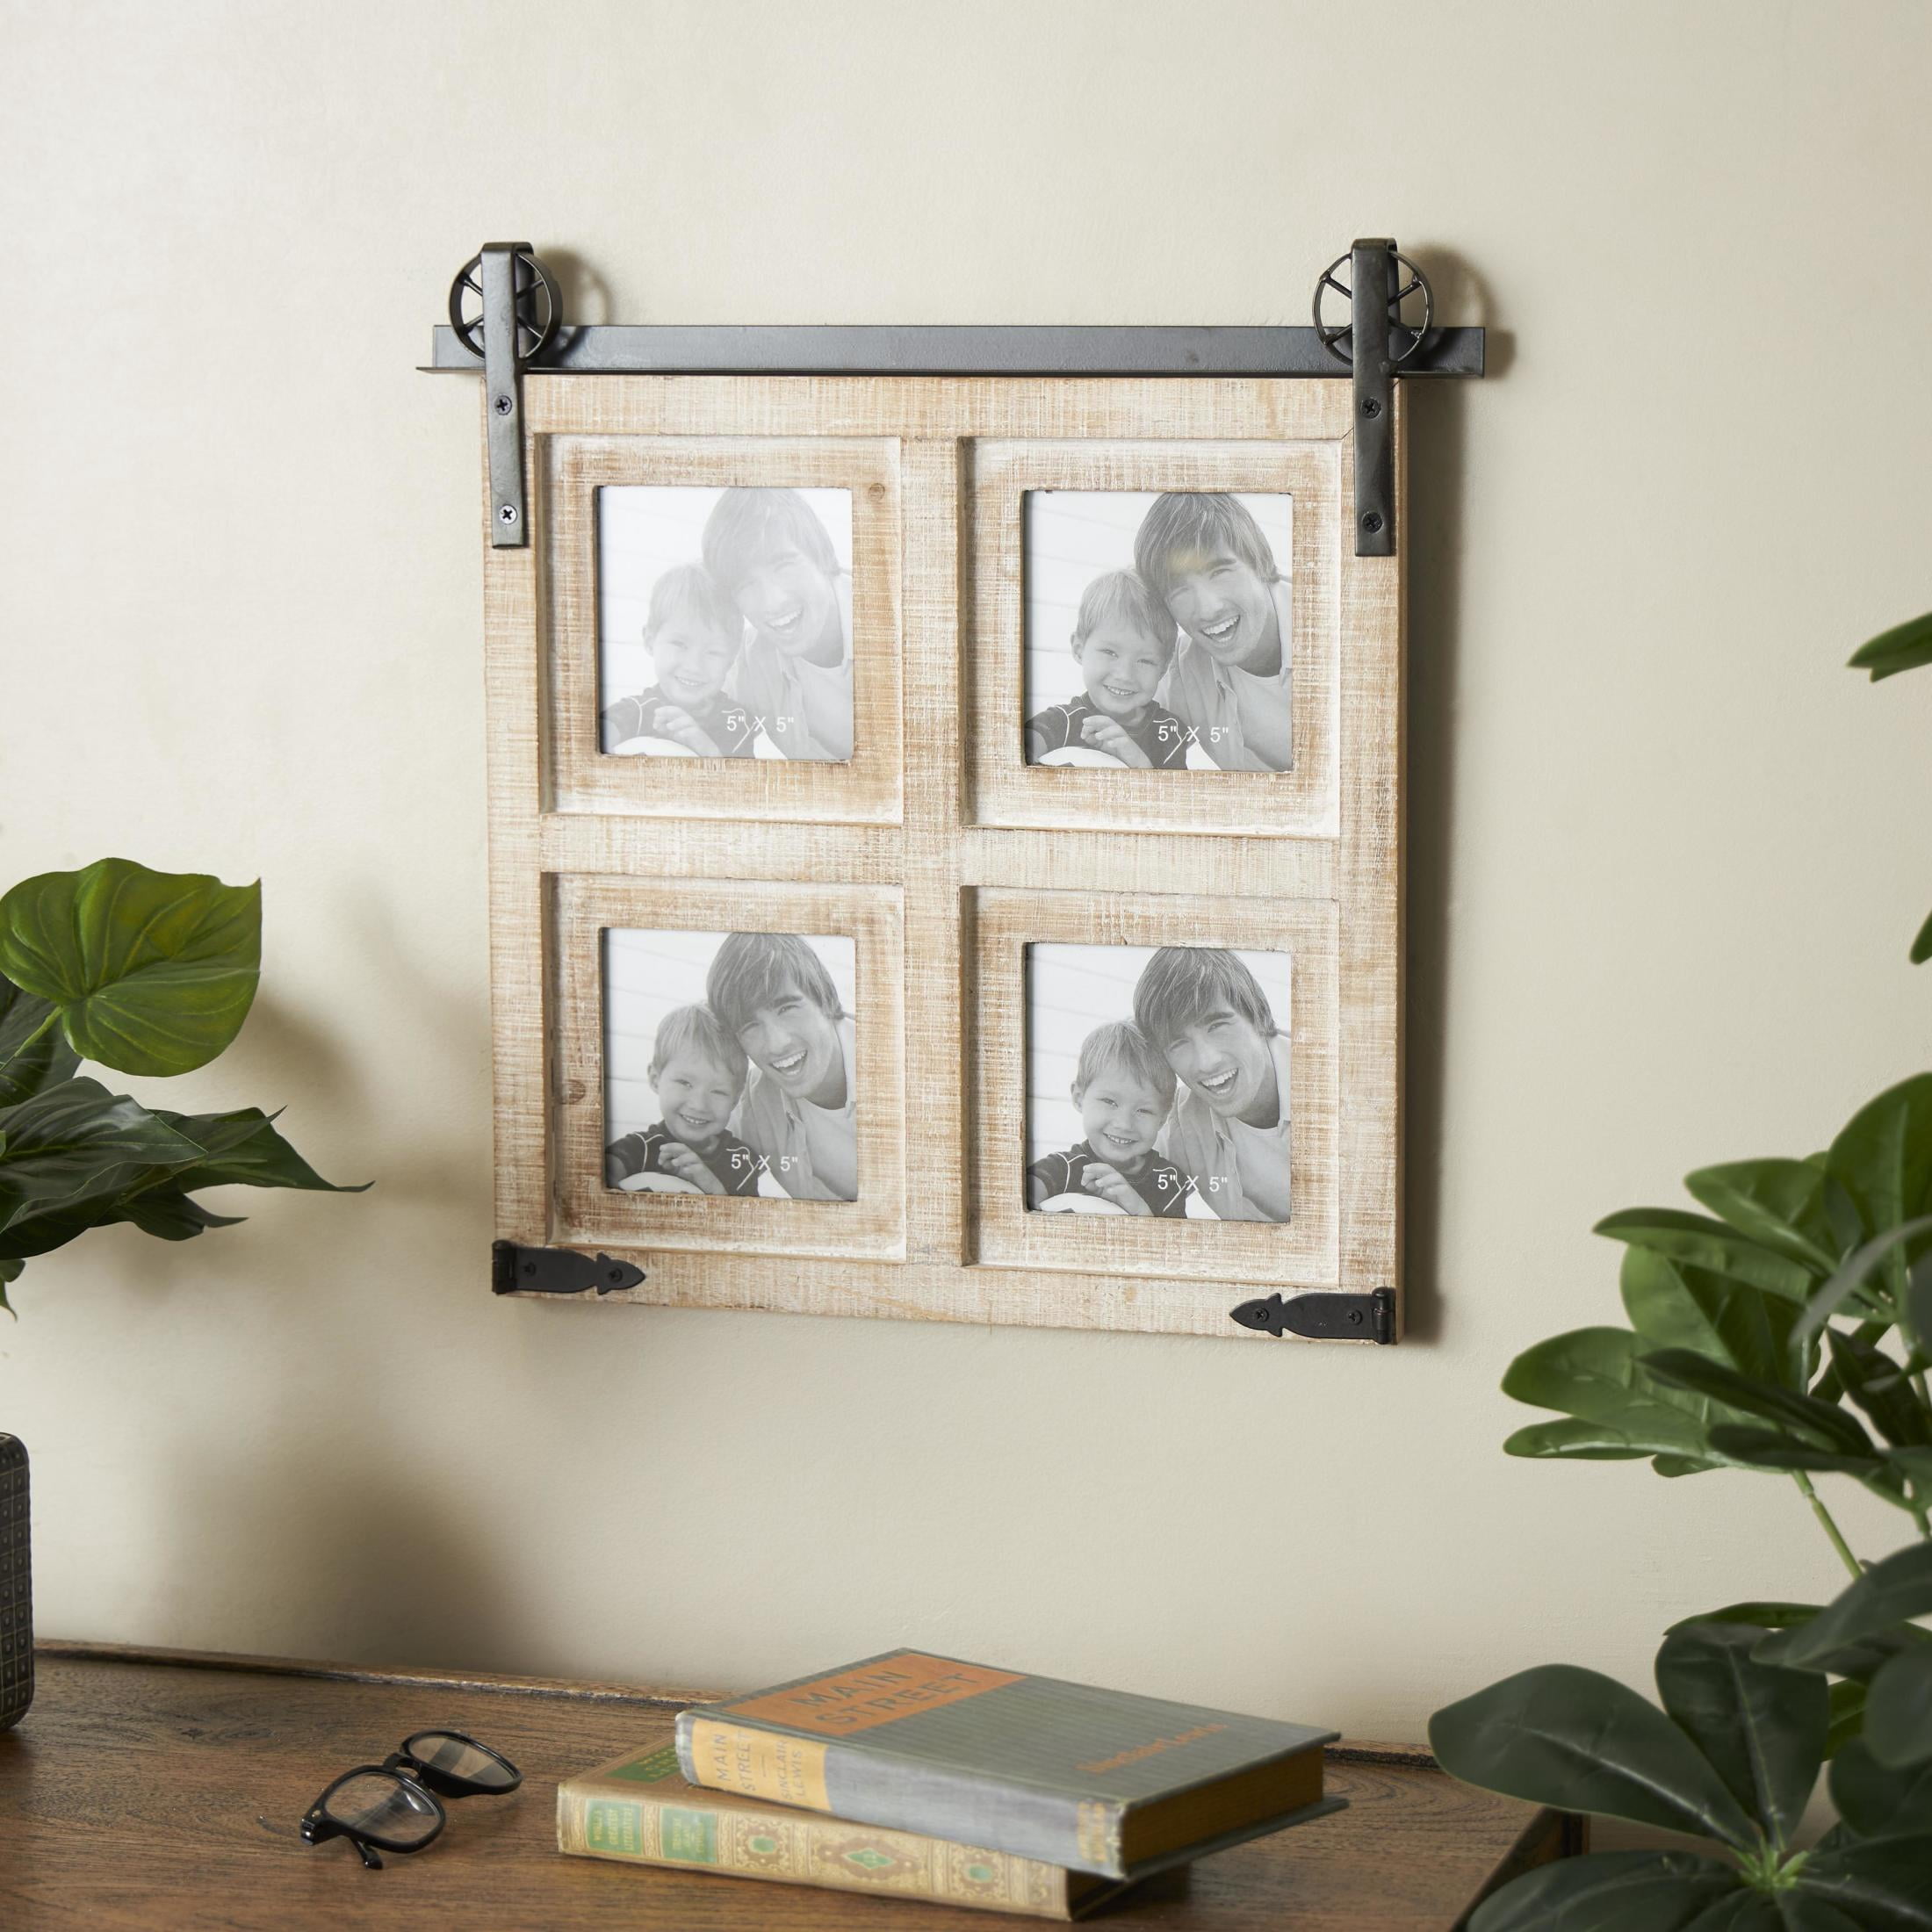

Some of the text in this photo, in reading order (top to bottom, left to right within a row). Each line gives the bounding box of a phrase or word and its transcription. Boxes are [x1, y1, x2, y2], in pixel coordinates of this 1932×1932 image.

[726, 716, 745, 732] 5"
[775, 717, 795, 732] 5"
[1157, 725, 1178, 742] 5"
[1210, 726, 1229, 743] 5"
[731, 1153, 749, 1170] 5"
[780, 1156, 799, 1171] 5"
[1157, 1174, 1177, 1190] 5"
[1208, 1176, 1228, 1193] 5"
[789, 1670, 912, 1707] MAIN
[815, 1672, 980, 1724] STREET
[713, 1733, 731, 1783] MAIN
[736, 1728, 756, 1792] STREET
[775, 1739, 793, 1800] SINCLAIR
[791, 1749, 807, 1798] LEWIS
